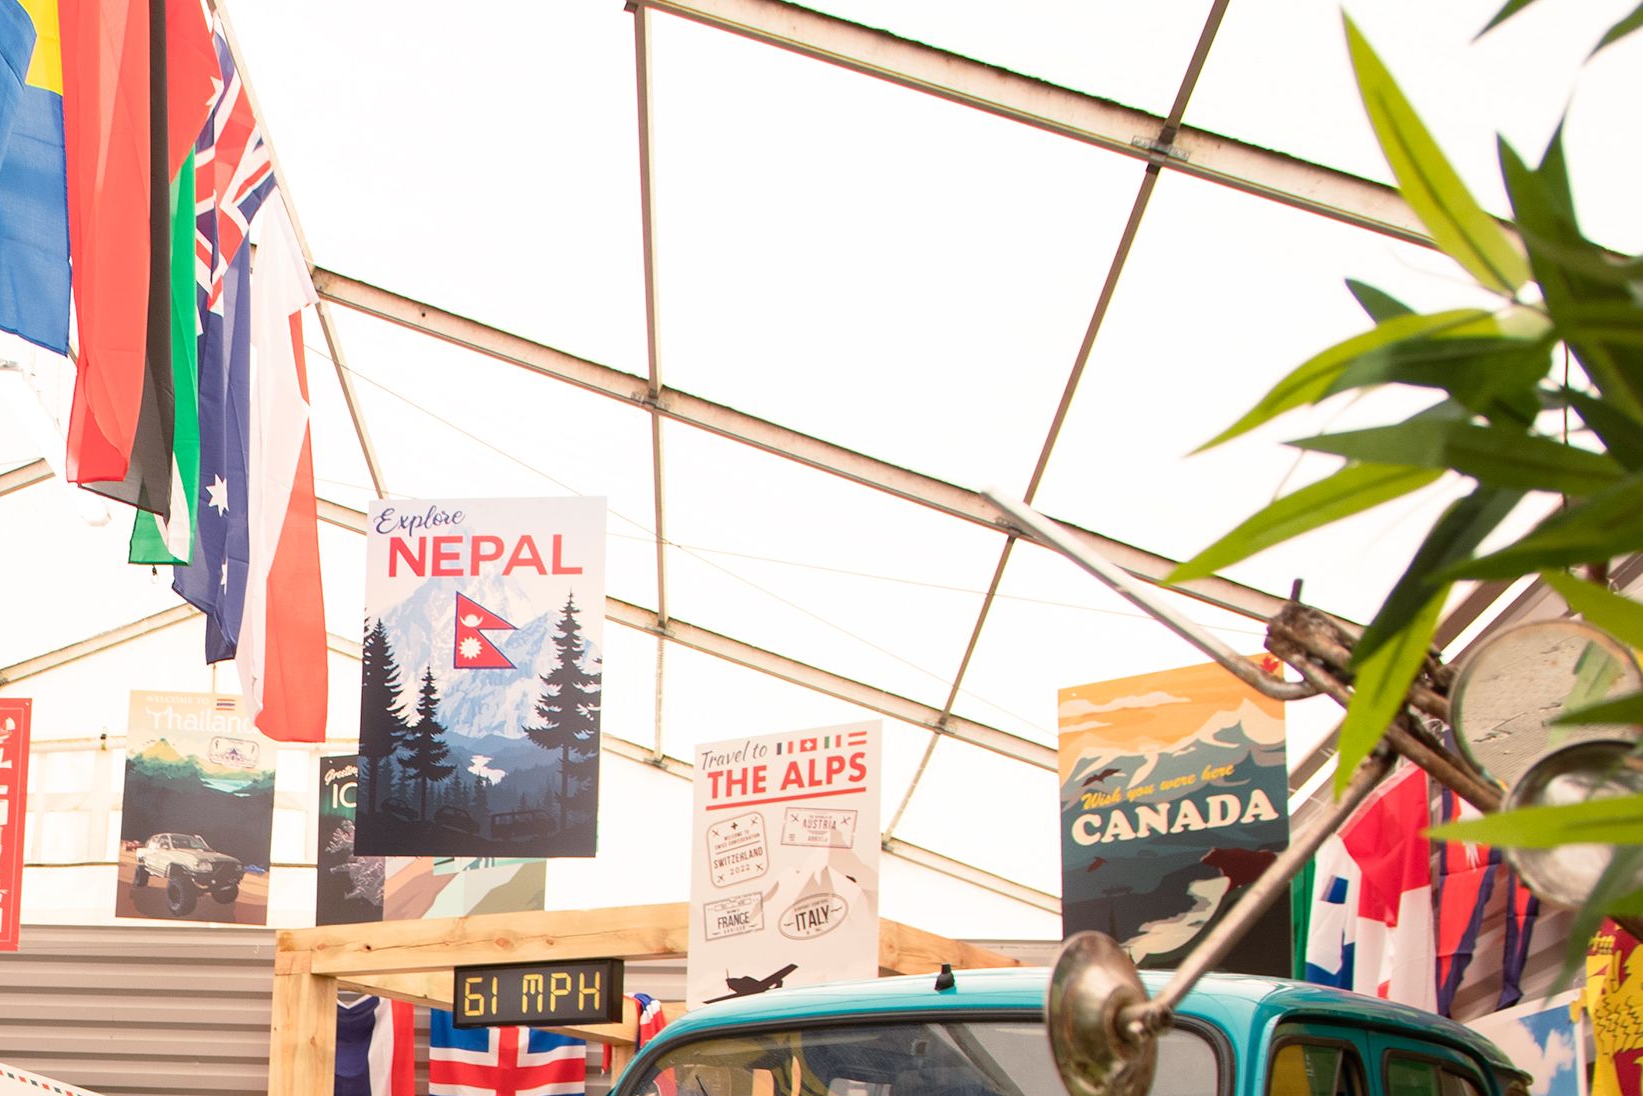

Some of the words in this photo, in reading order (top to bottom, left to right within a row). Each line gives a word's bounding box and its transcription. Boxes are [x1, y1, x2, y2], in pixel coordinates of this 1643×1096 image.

[373, 504, 465, 537] Explore
[388, 534, 583, 577] NEPAL
[146, 696, 192, 704] WELCOME
[196, 696, 210, 704] TO
[701, 740, 751, 771] Travel
[752, 742, 768, 760] to
[707, 765, 768, 799] THE
[780, 751, 867, 791] ALPS
[1081, 786, 1122, 810] Wish
[1126, 783, 1155, 803] you
[1160, 773, 1197, 791] were
[1201, 763, 1235, 782] here
[802, 818, 837, 831] AUSTRIA
[1071, 789, 1280, 846] CANADA
[713, 846, 764, 870] SWITZERLAND
[717, 911, 750, 930] FRANCE
[795, 904, 830, 932] ITALY
[464, 975, 498, 1017] 61
[521, 970, 602, 1015] MPH
